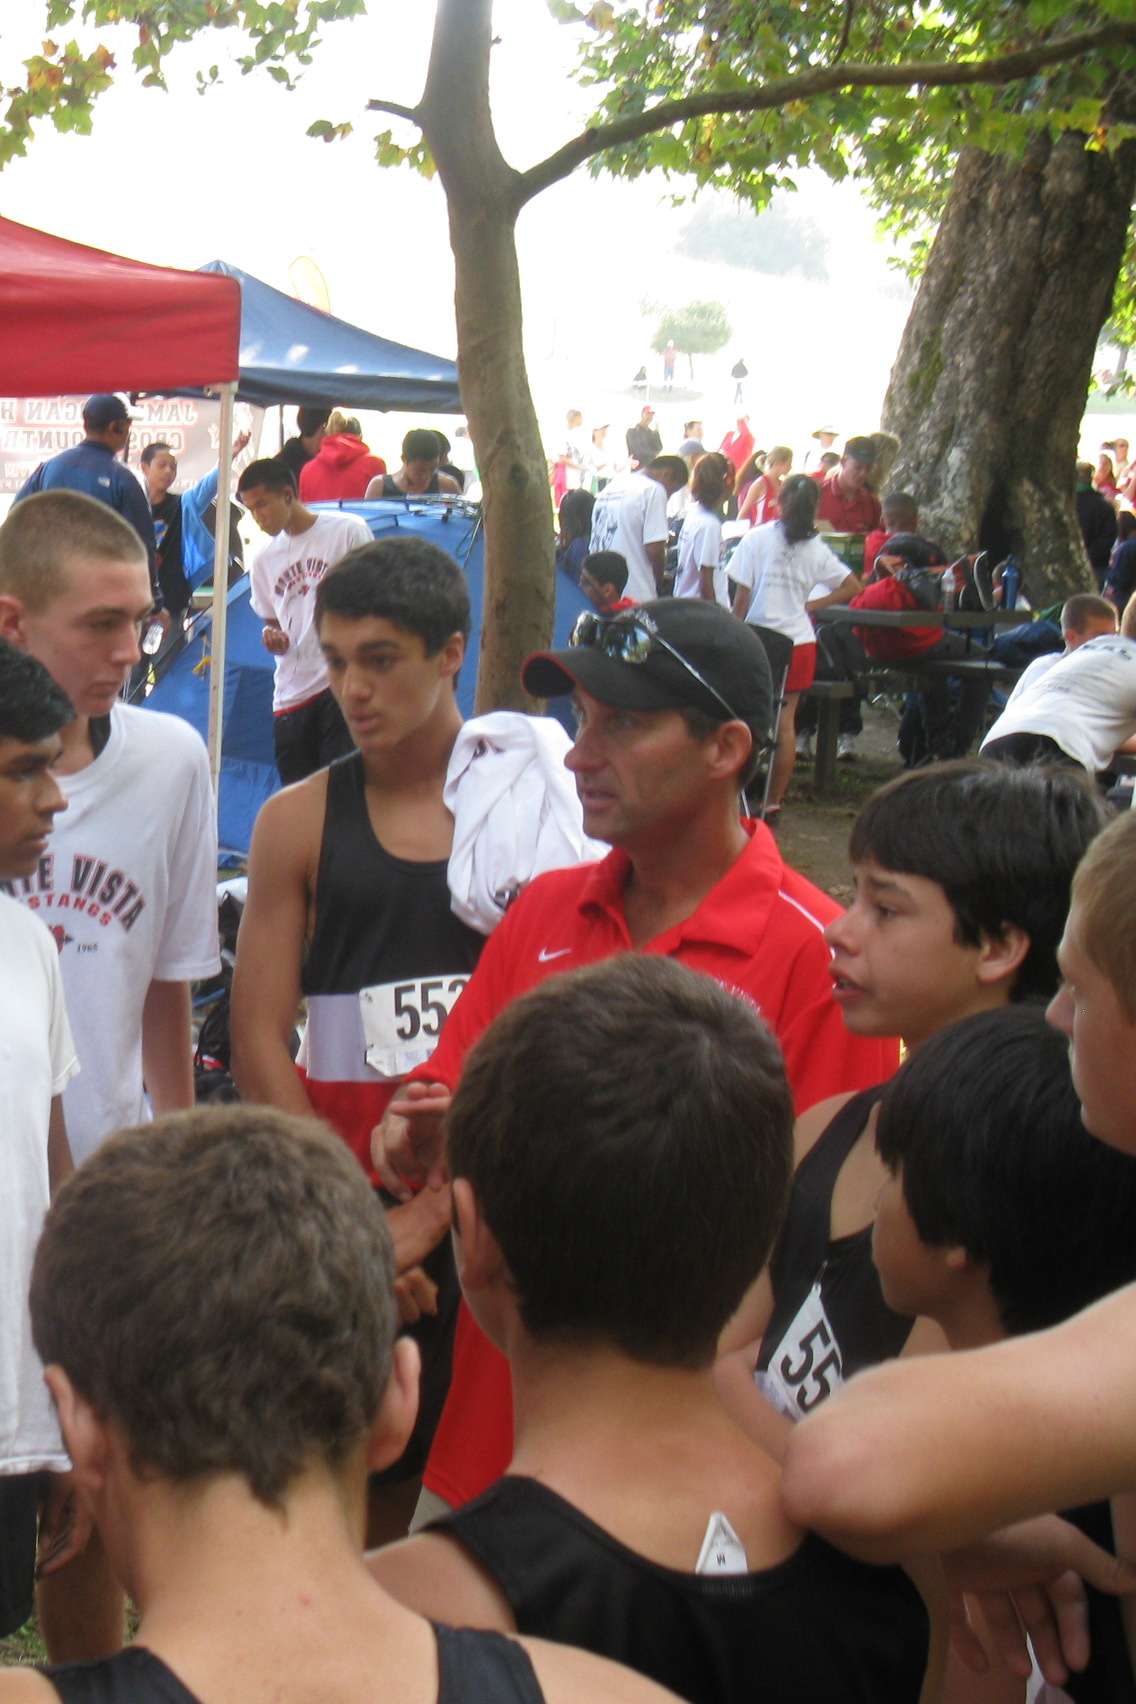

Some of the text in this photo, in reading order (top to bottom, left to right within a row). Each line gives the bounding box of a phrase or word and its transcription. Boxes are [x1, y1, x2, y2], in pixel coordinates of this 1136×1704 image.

[306, 557, 328, 573] VIST
[70, 853, 145, 932] VISTA
[27, 893, 113, 926] STANGS
